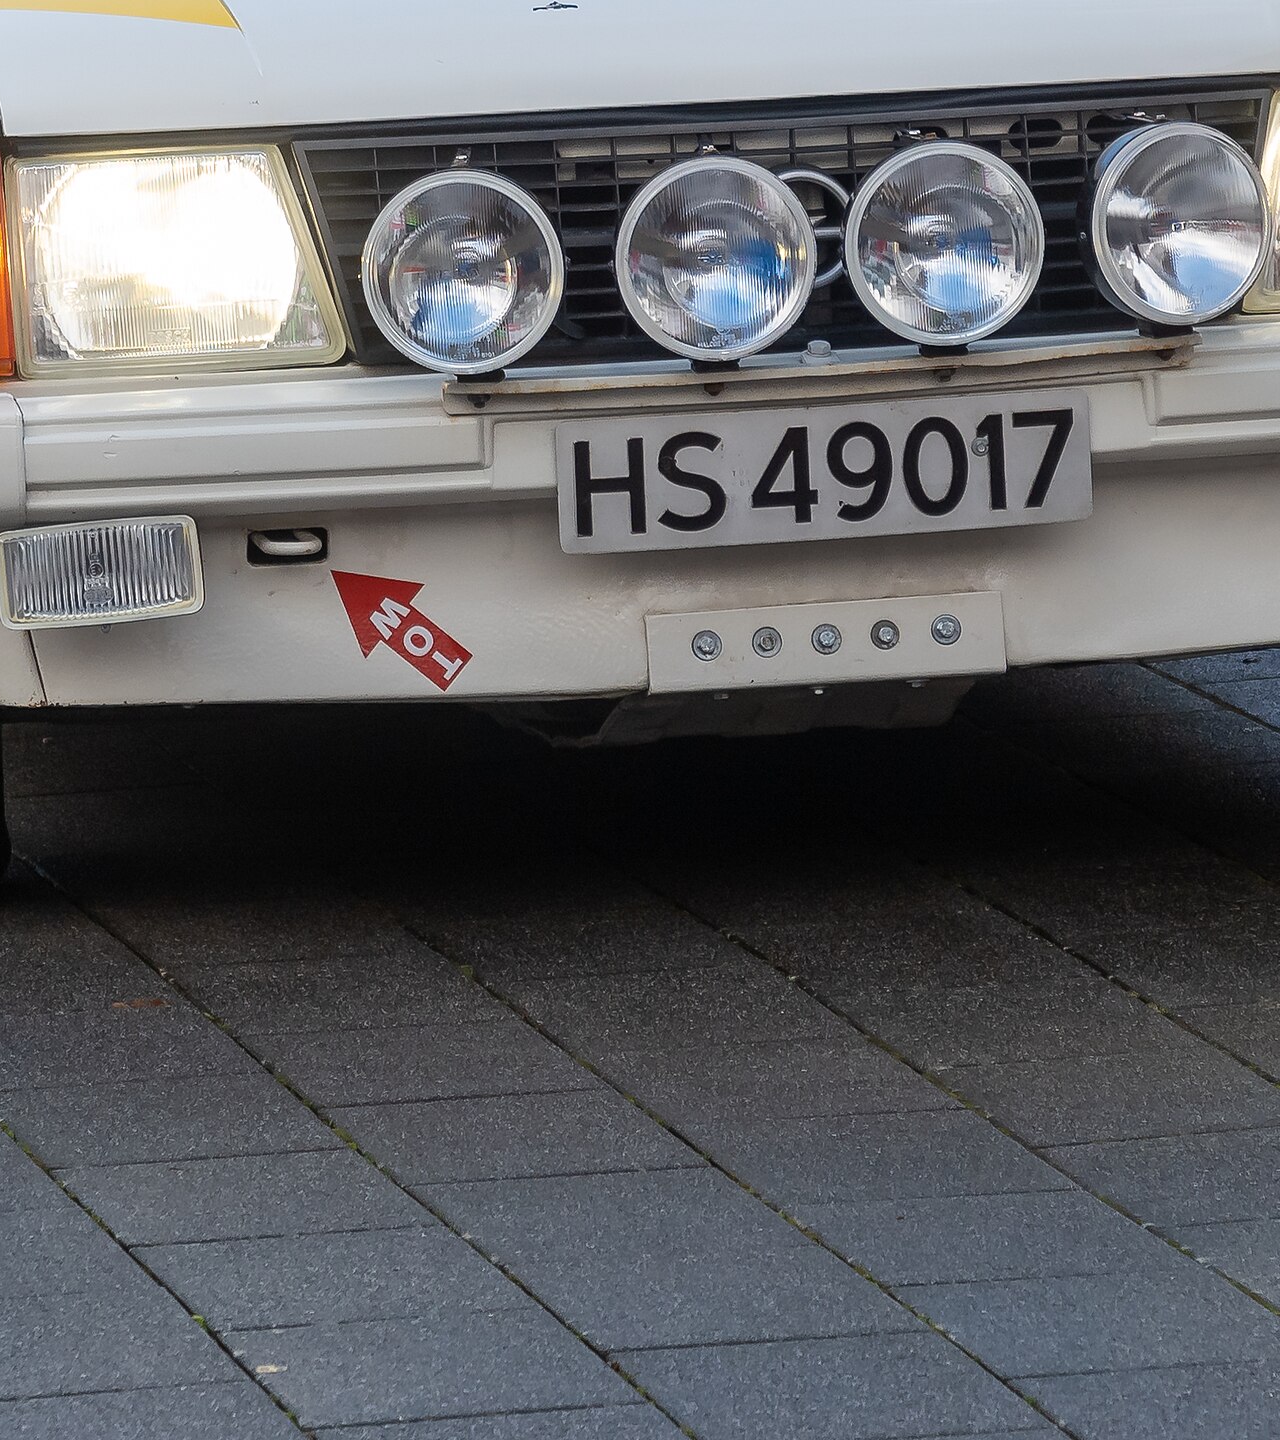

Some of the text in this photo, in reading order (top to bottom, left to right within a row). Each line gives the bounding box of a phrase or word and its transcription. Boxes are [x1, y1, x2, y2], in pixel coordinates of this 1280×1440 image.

[573, 407, 1074, 538] HS 49017
[369, 597, 464, 681] TOW
